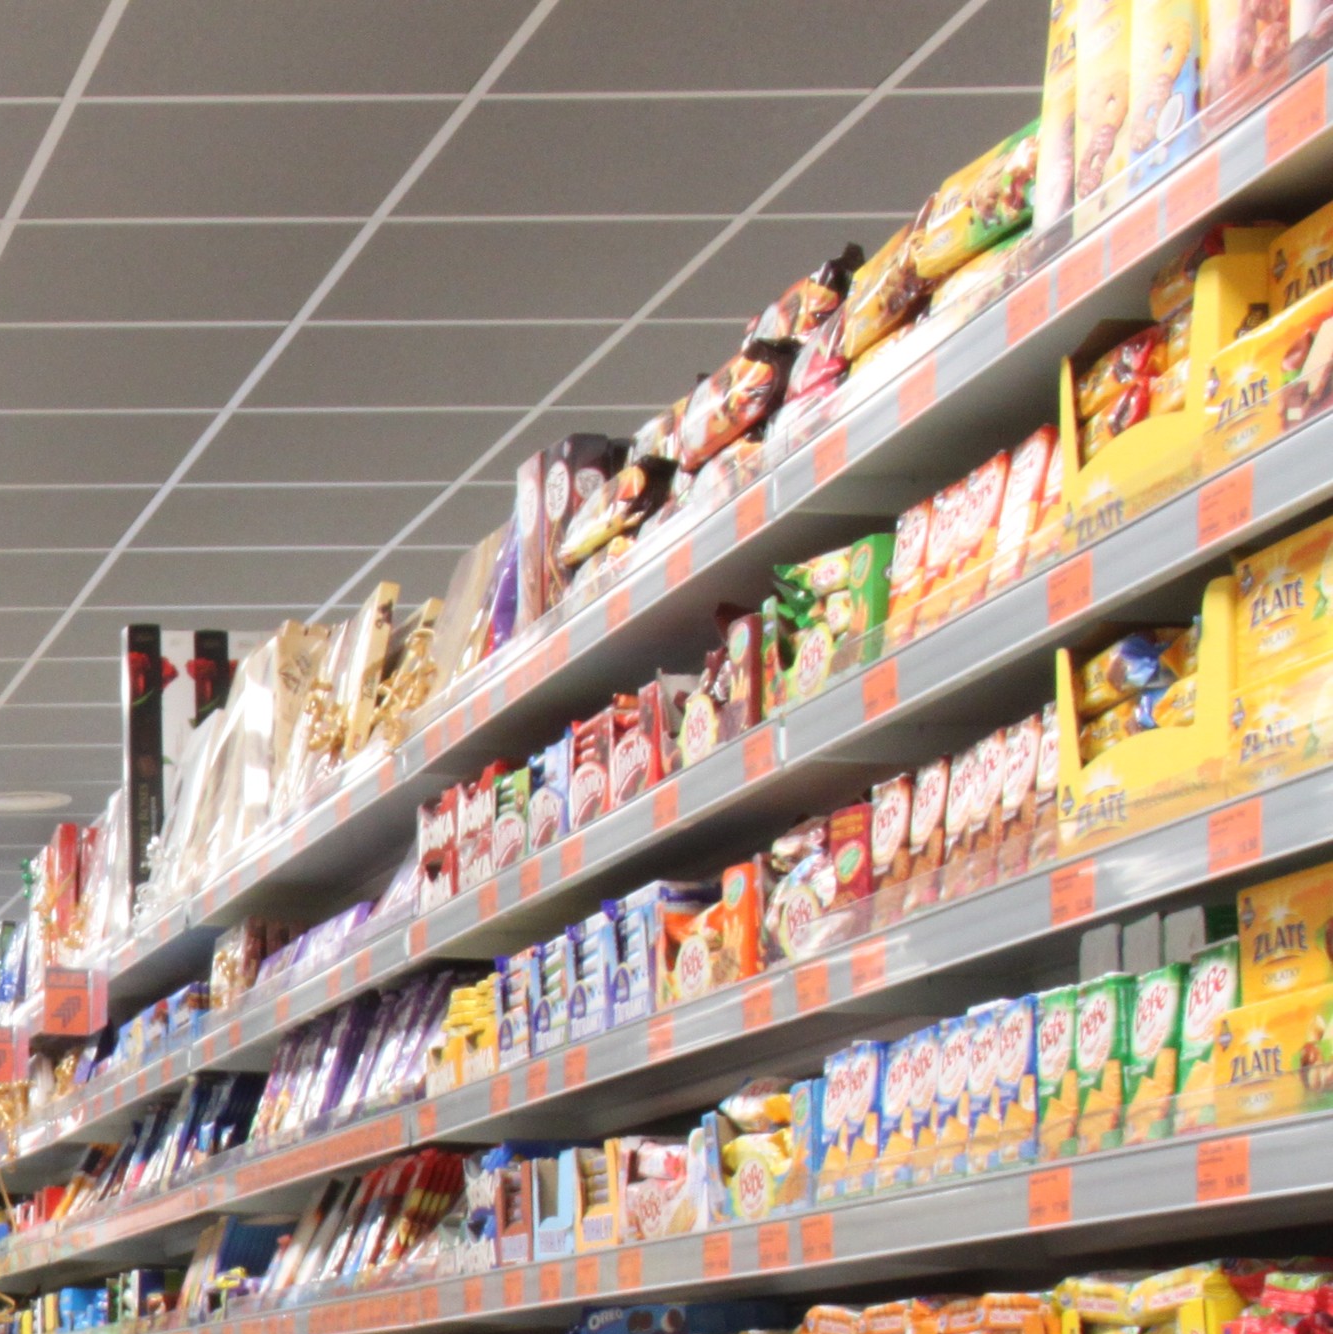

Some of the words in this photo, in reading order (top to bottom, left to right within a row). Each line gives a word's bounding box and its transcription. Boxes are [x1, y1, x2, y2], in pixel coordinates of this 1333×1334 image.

[1253, 920, 1309, 963] ZLATÉ
[1230, 1046, 1283, 1085] ZLATÉ
[588, 1308, 624, 1332] OREO
